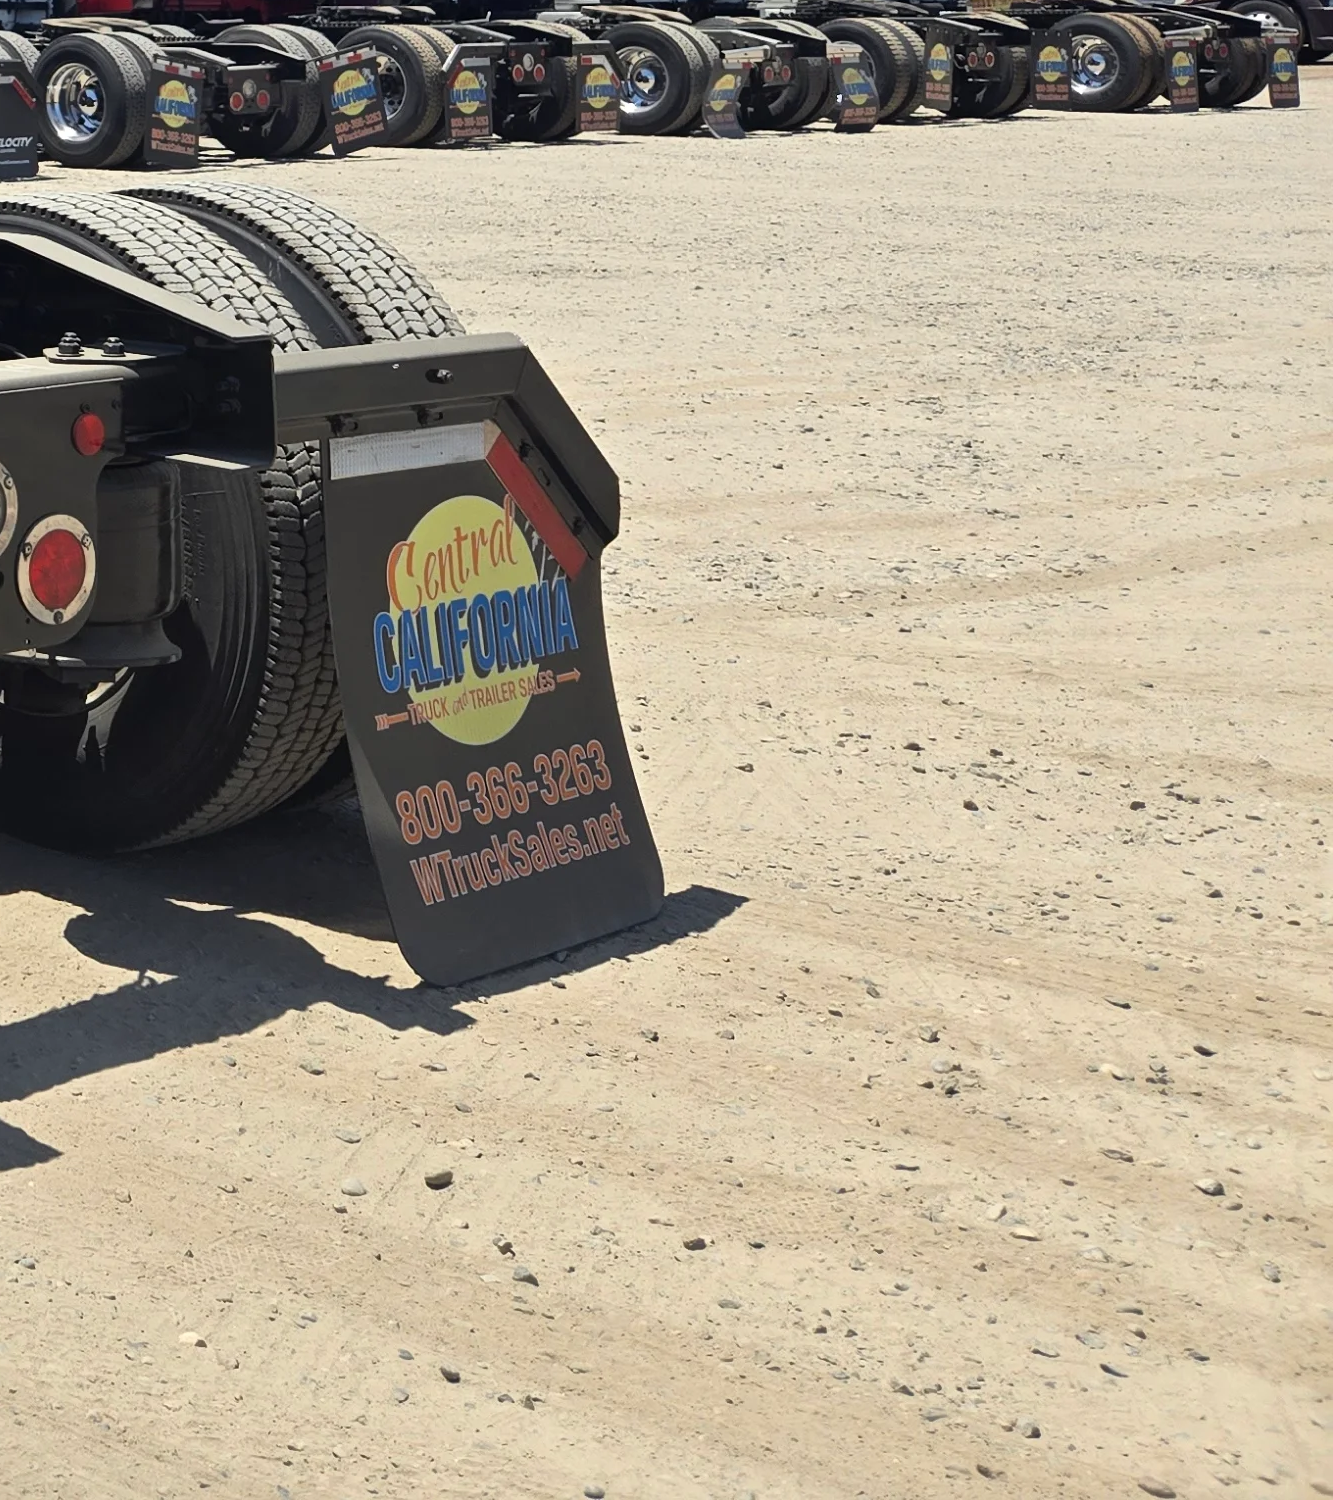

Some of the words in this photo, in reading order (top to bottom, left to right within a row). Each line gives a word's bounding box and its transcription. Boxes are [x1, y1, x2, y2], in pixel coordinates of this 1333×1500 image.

[387, 493, 519, 614] Central
[373, 577, 579, 694] CALIFORNIA
[408, 700, 450, 727] TRUCK
[452, 689, 471, 713] and
[472, 683, 517, 710] TRAILER
[519, 669, 557, 697] SALES
[396, 739, 614, 846] 800-366-3263
[410, 803, 630, 907] WTruckSales.net
